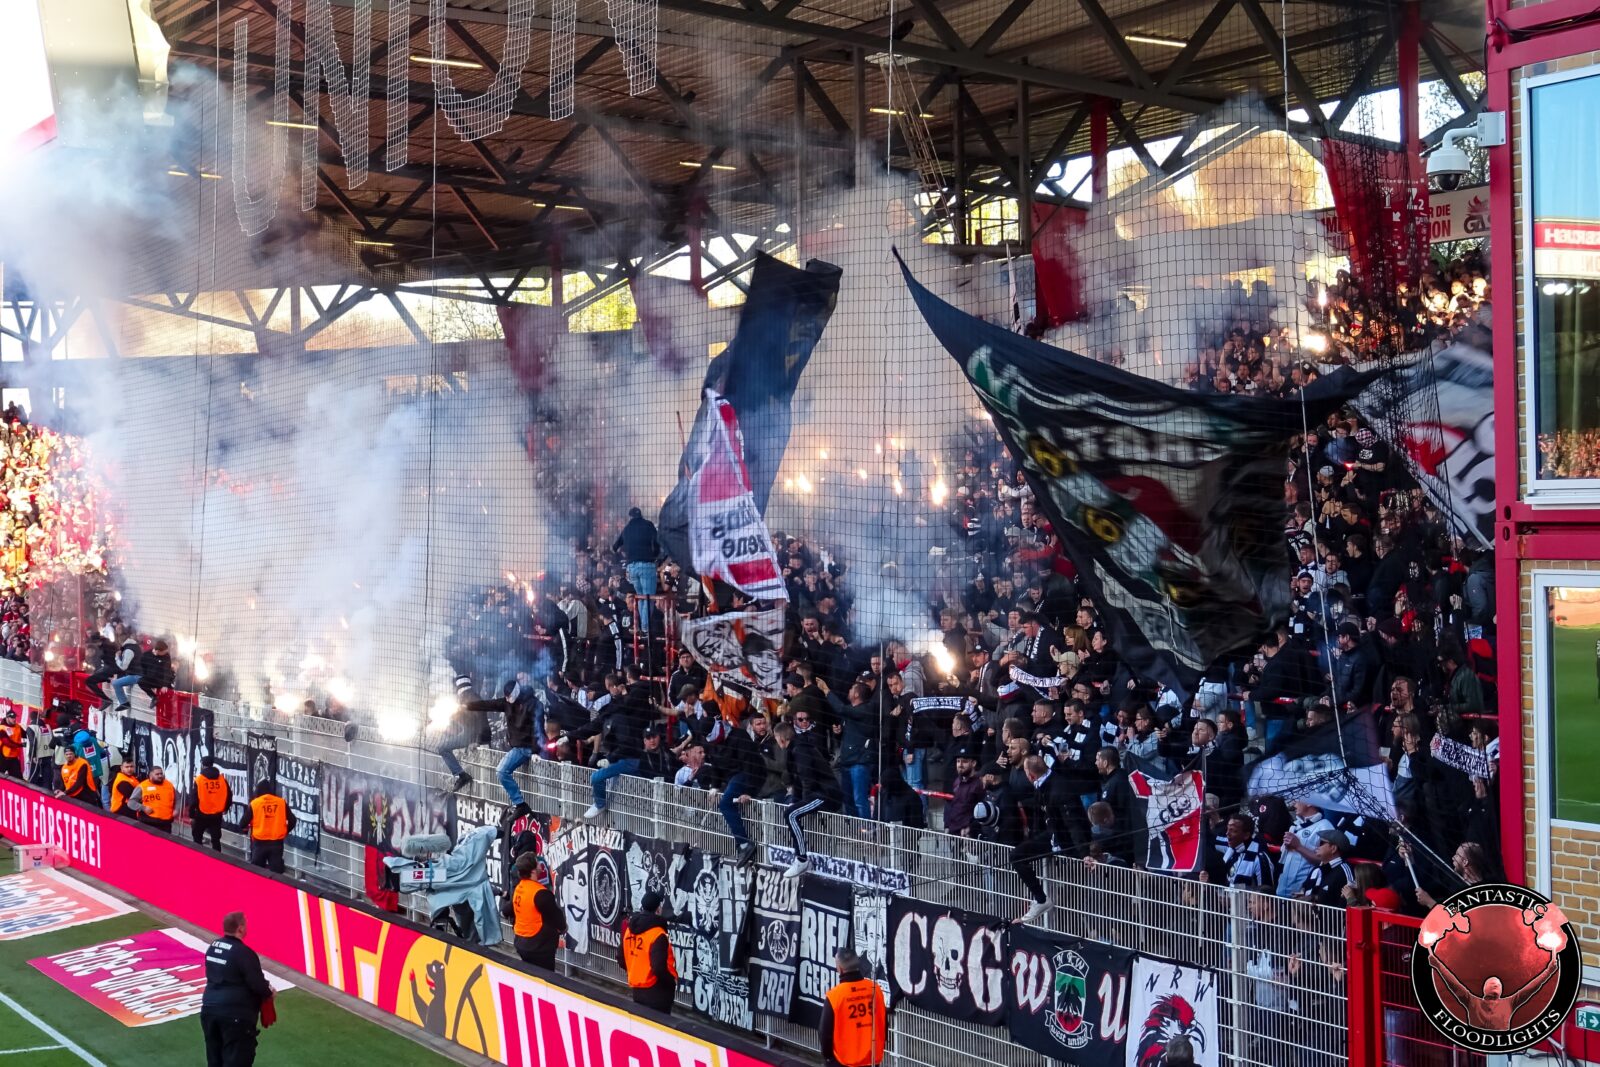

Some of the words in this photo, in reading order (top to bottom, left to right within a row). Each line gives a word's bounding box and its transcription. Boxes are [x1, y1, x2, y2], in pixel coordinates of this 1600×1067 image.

[1436, 204, 1451, 217] DIE
[279, 757, 316, 786] ULTRAS
[205, 782, 220, 790] 135
[262, 804, 278, 815] 167
[0, 789, 29, 838] LTEN
[32, 796, 101, 869] FÖRSTEREI
[590, 923, 621, 948] ULTRAS
[758, 925, 767, 951] 3
[847, 1000, 874, 1020] 295
